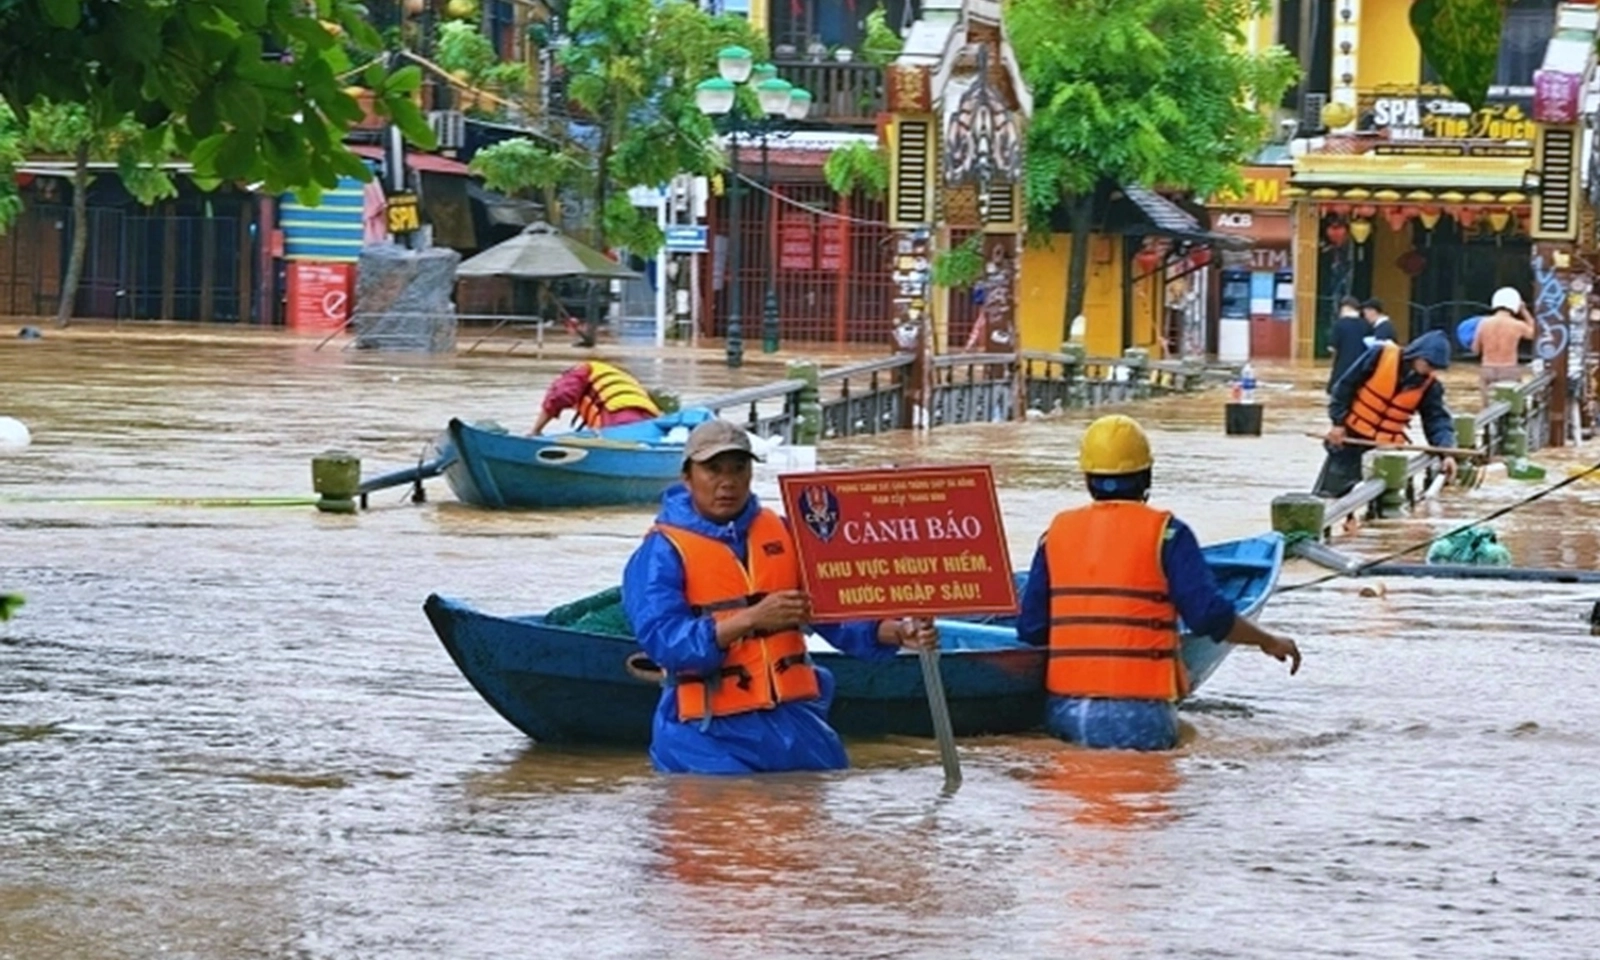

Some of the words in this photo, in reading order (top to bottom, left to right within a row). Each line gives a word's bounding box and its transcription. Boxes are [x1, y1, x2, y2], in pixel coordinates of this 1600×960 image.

[1374, 99, 1420, 126] SPA
[1434, 117, 1469, 138] The
[1471, 107, 1535, 139] Touch
[390, 205, 419, 231] SPA
[1217, 213, 1252, 228] ACB
[843, 511, 919, 544] CẢNH
[925, 509, 981, 539] BÁO
[816, 561, 852, 579] KHU
[855, 558, 890, 580] VỰC
[893, 555, 938, 575] NGUY
[889, 579, 936, 606] NGẬP
[940, 580, 982, 600] SÂU!
